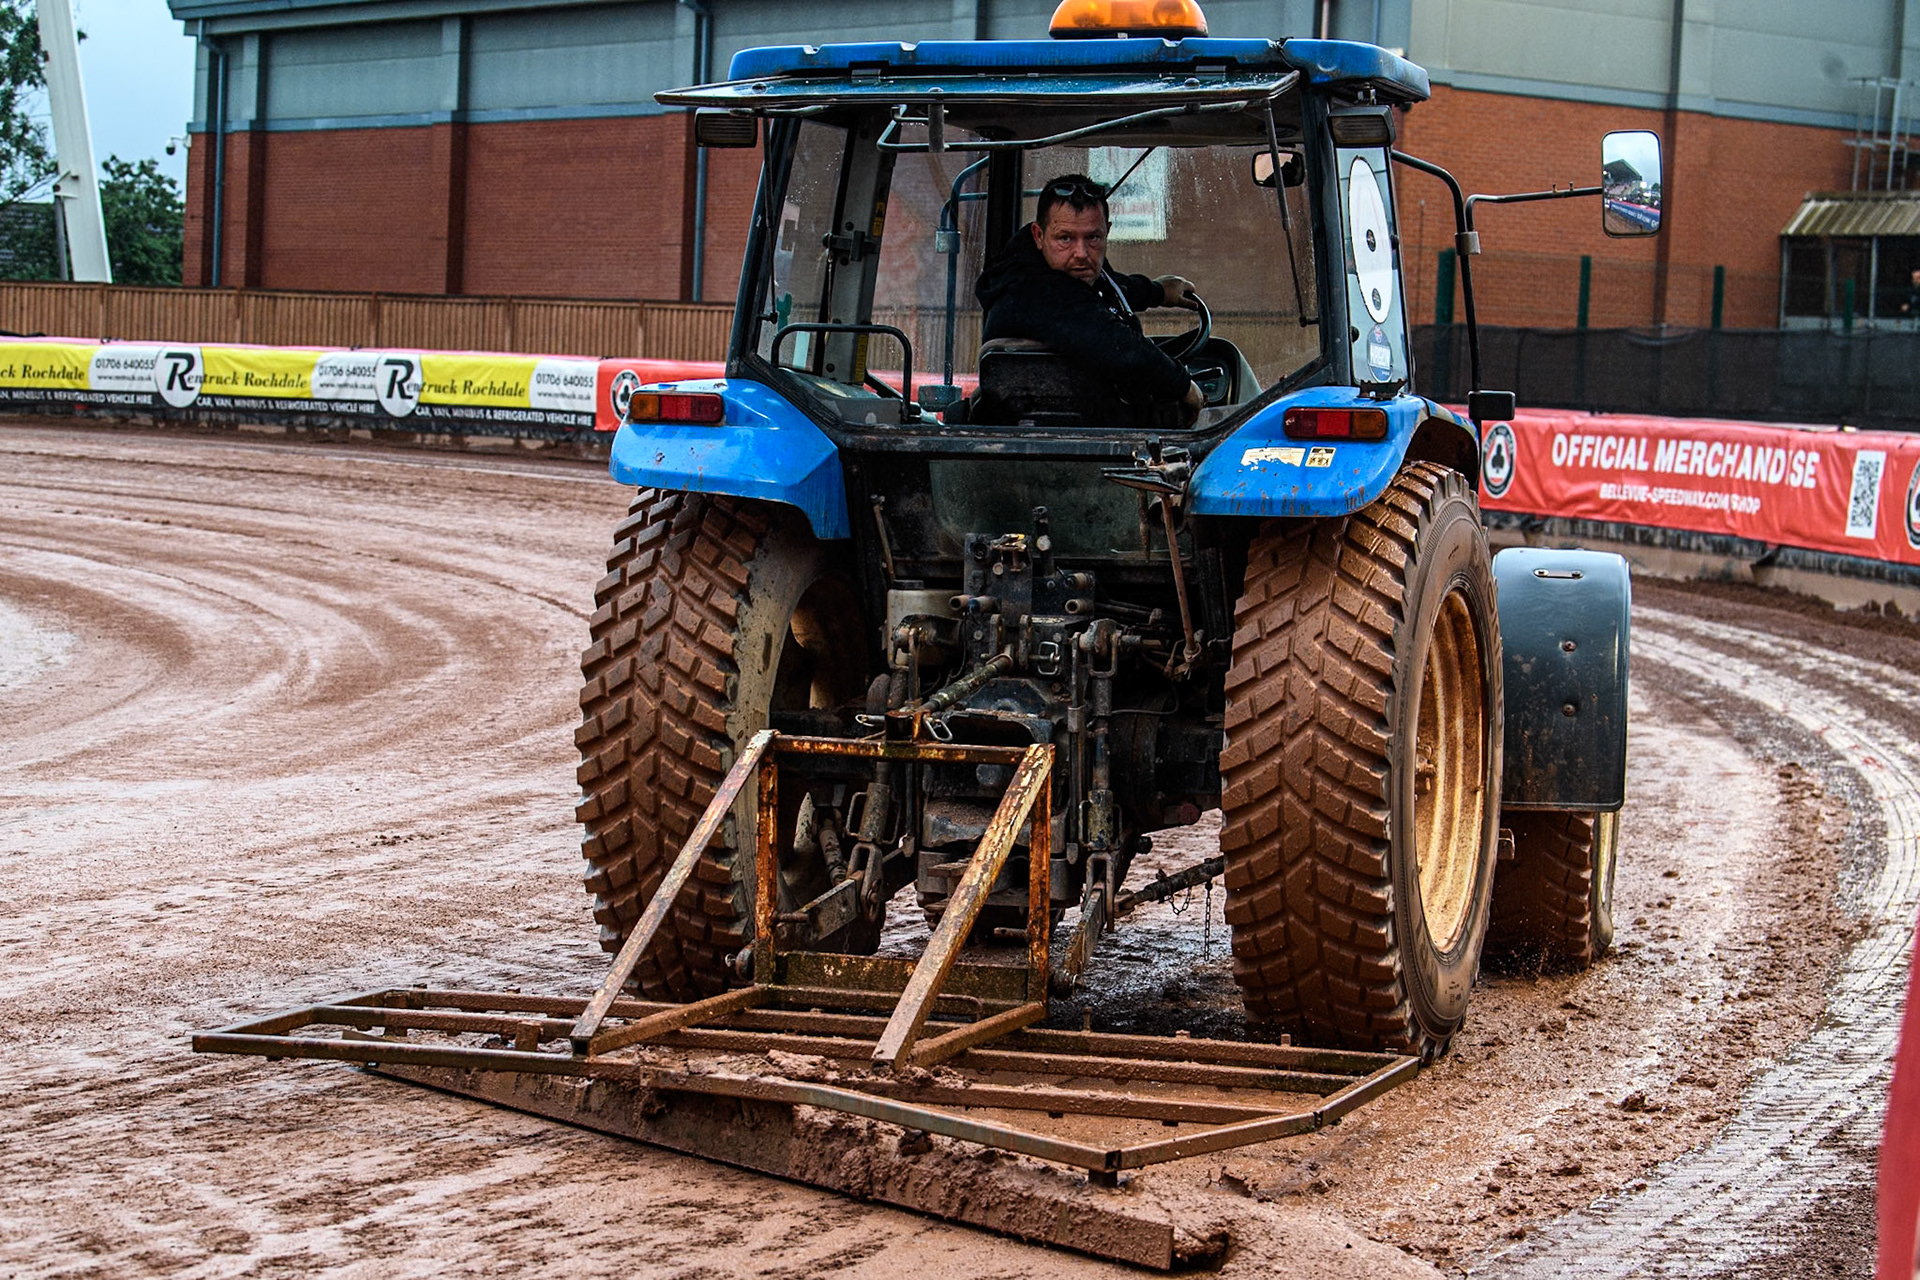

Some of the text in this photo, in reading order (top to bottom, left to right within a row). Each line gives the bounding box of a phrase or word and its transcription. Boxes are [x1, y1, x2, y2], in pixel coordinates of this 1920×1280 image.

[95, 358, 155, 370] 01706 640055
[318, 365, 376, 378] 01706 640055
[22, 364, 85, 380] Rochdale
[243, 371, 308, 389] Rochdale
[535, 373, 594, 388] 01706 640055
[462, 379, 526, 397] Rochdale
[106, 394, 135, 404] VEHICLE
[136, 394, 153, 405] HIRE
[234, 399, 267, 410] MINIBUS
[329, 402, 357, 413] VEHICLE
[358, 404, 376, 414] HIRE
[452, 408, 485, 419] MINIBUS
[493, 410, 545, 422] REFRIGERATED
[546, 412, 576, 425] VEHICLE
[577, 415, 592, 427] HIRE
[1552, 433, 1648, 471] OFFICIAL
[1653, 439, 1820, 489] MERCHANDISE
